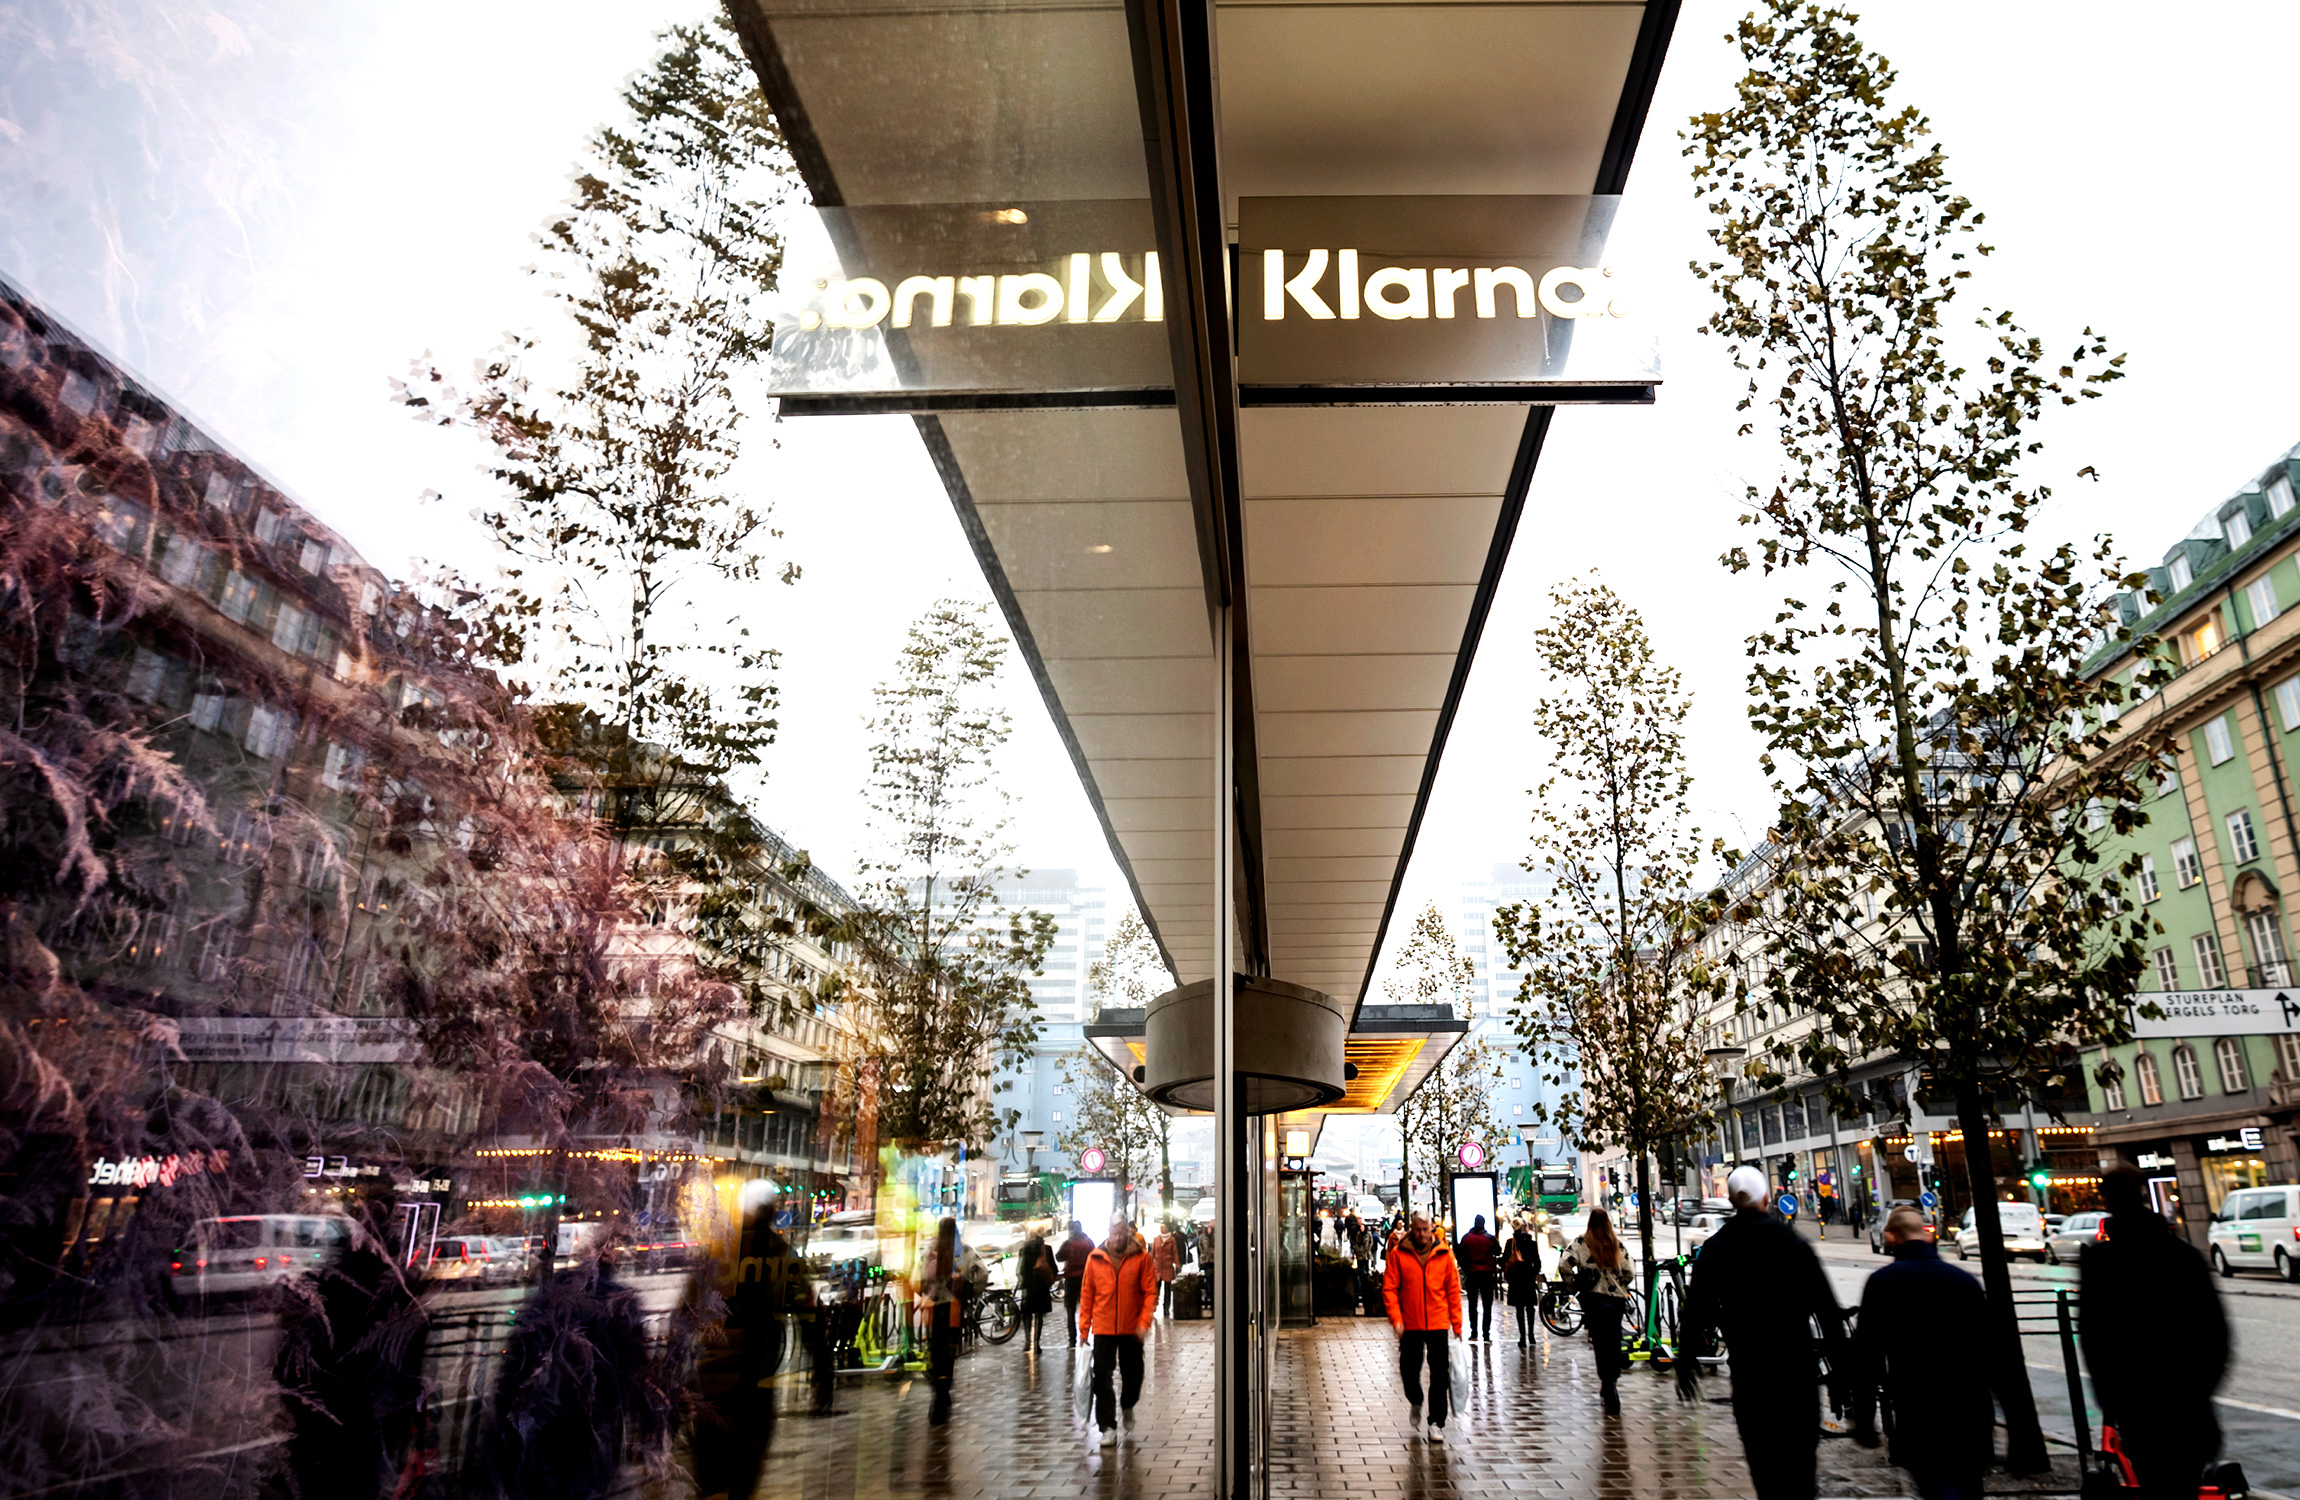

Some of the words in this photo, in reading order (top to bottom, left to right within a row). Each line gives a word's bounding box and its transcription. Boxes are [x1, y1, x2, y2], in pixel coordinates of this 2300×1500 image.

[2166, 993, 2244, 1005] STUREPLAN
[2166, 1005, 2216, 1018] ERGELS
[2223, 1004, 2260, 1015] TORG
